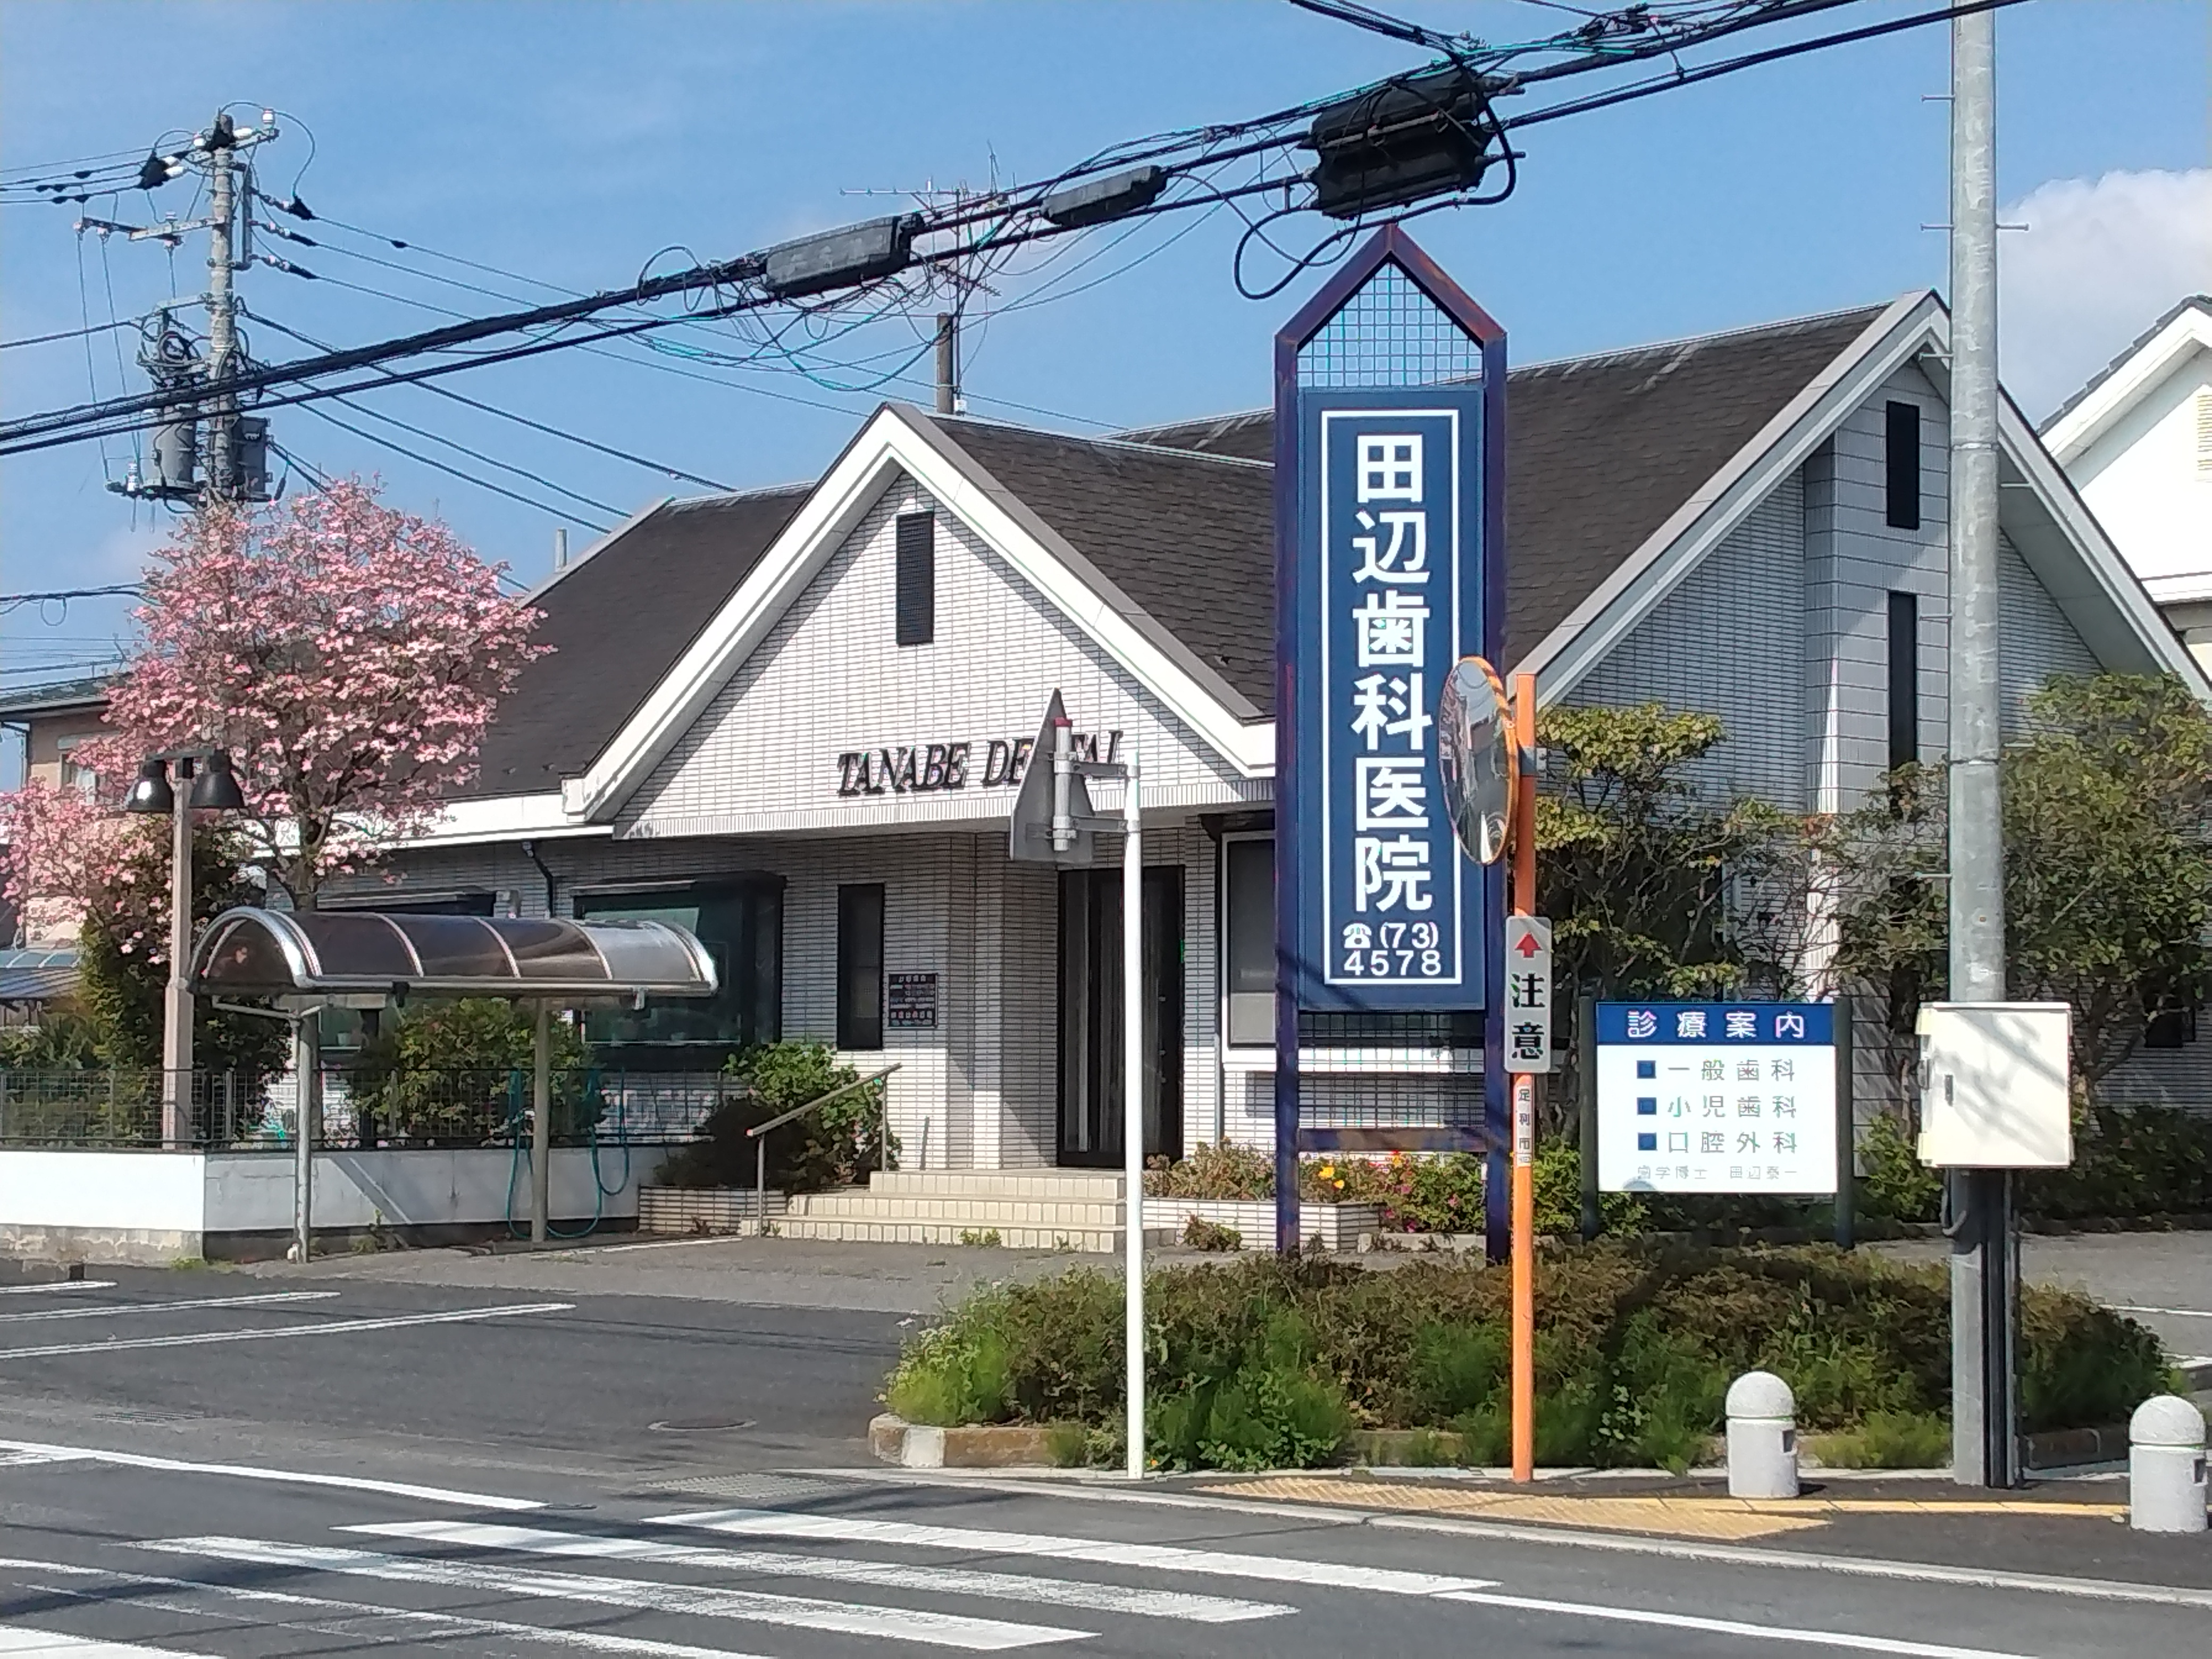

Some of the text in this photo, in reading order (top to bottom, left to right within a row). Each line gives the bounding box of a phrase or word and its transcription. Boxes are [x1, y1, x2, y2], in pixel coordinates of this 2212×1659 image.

[1351, 433, 1432, 912] 田辺歯科医院
[837, 742, 971, 797] TANABE
[1344, 950, 1441, 976] 4578
[1511, 973, 1545, 1060] 注意
[1627, 1010, 1805, 1038] 診療案内
[1668, 1059, 1795, 1082] 一般歯科
[1668, 1095, 1797, 1118] 小児歯科
[1668, 1130, 1798, 1154] 口腔外科
